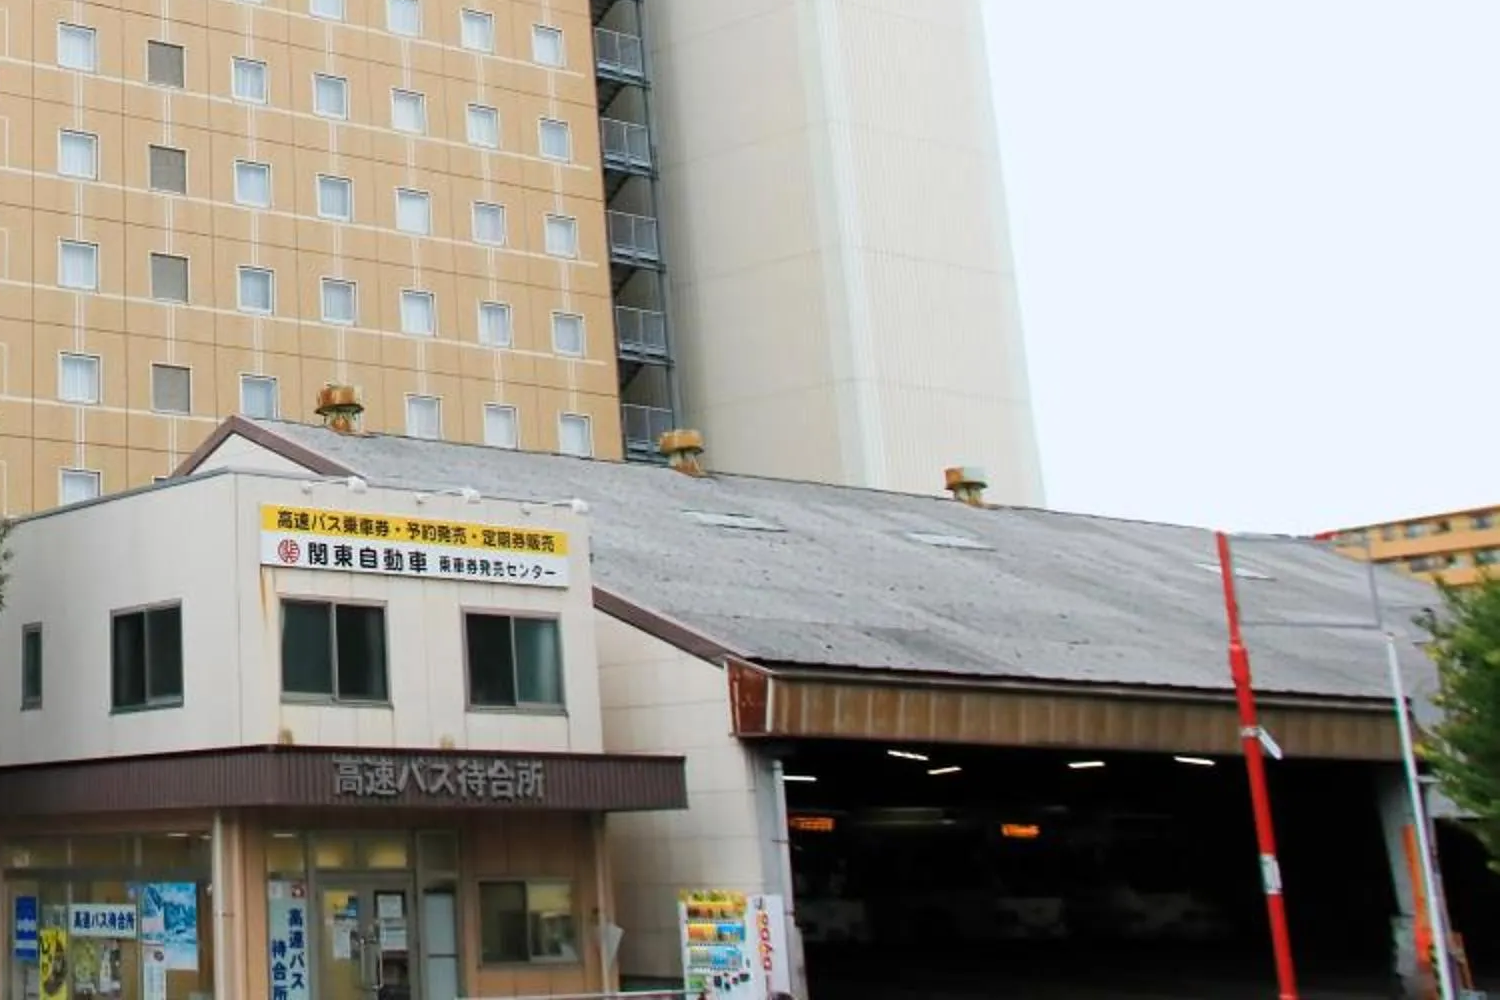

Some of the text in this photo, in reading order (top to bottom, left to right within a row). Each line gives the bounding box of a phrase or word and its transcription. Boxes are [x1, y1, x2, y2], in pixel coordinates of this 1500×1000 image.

[308, 541, 557, 579] 関東自動車 乗車券発売センター
[333, 754, 544, 798] 高速バス待合所
[73, 911, 135, 931] 高速バス待合所
[288, 907, 305, 990] 高速バス
